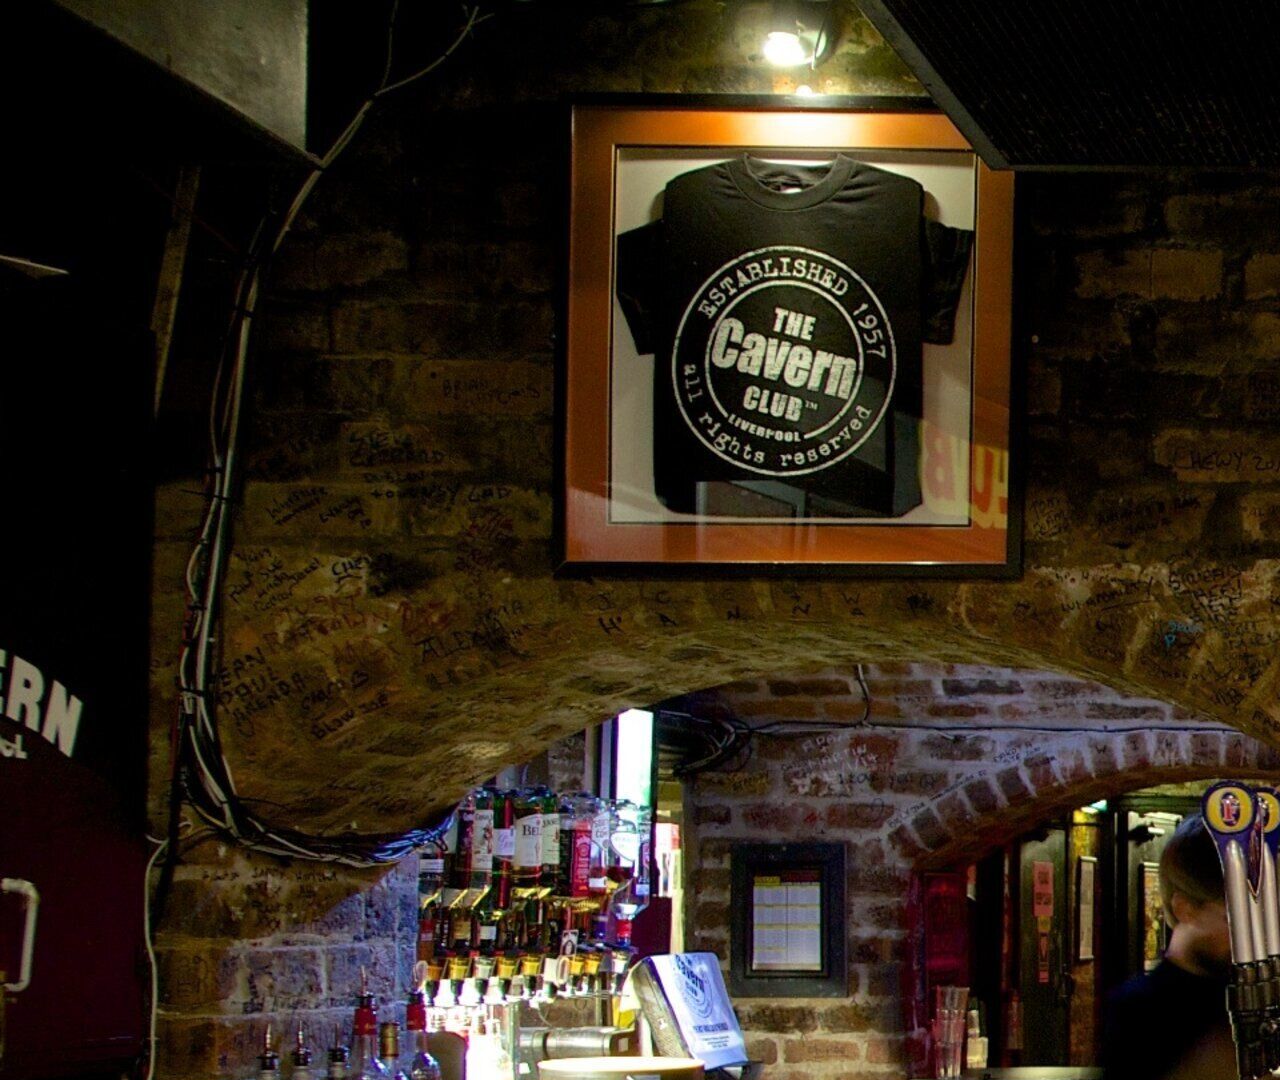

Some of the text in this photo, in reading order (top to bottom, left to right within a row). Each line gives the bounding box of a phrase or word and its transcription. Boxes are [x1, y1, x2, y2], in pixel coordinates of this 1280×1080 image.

[698, 257, 887, 359] ESTABLISHED 1957
[773, 307, 816, 341] THE
[711, 317, 857, 400] Cavern
[684, 363, 872, 466] all rights reserved
[728, 413, 801, 442] LIVERPOOL
[743, 385, 802, 422] CLUB
